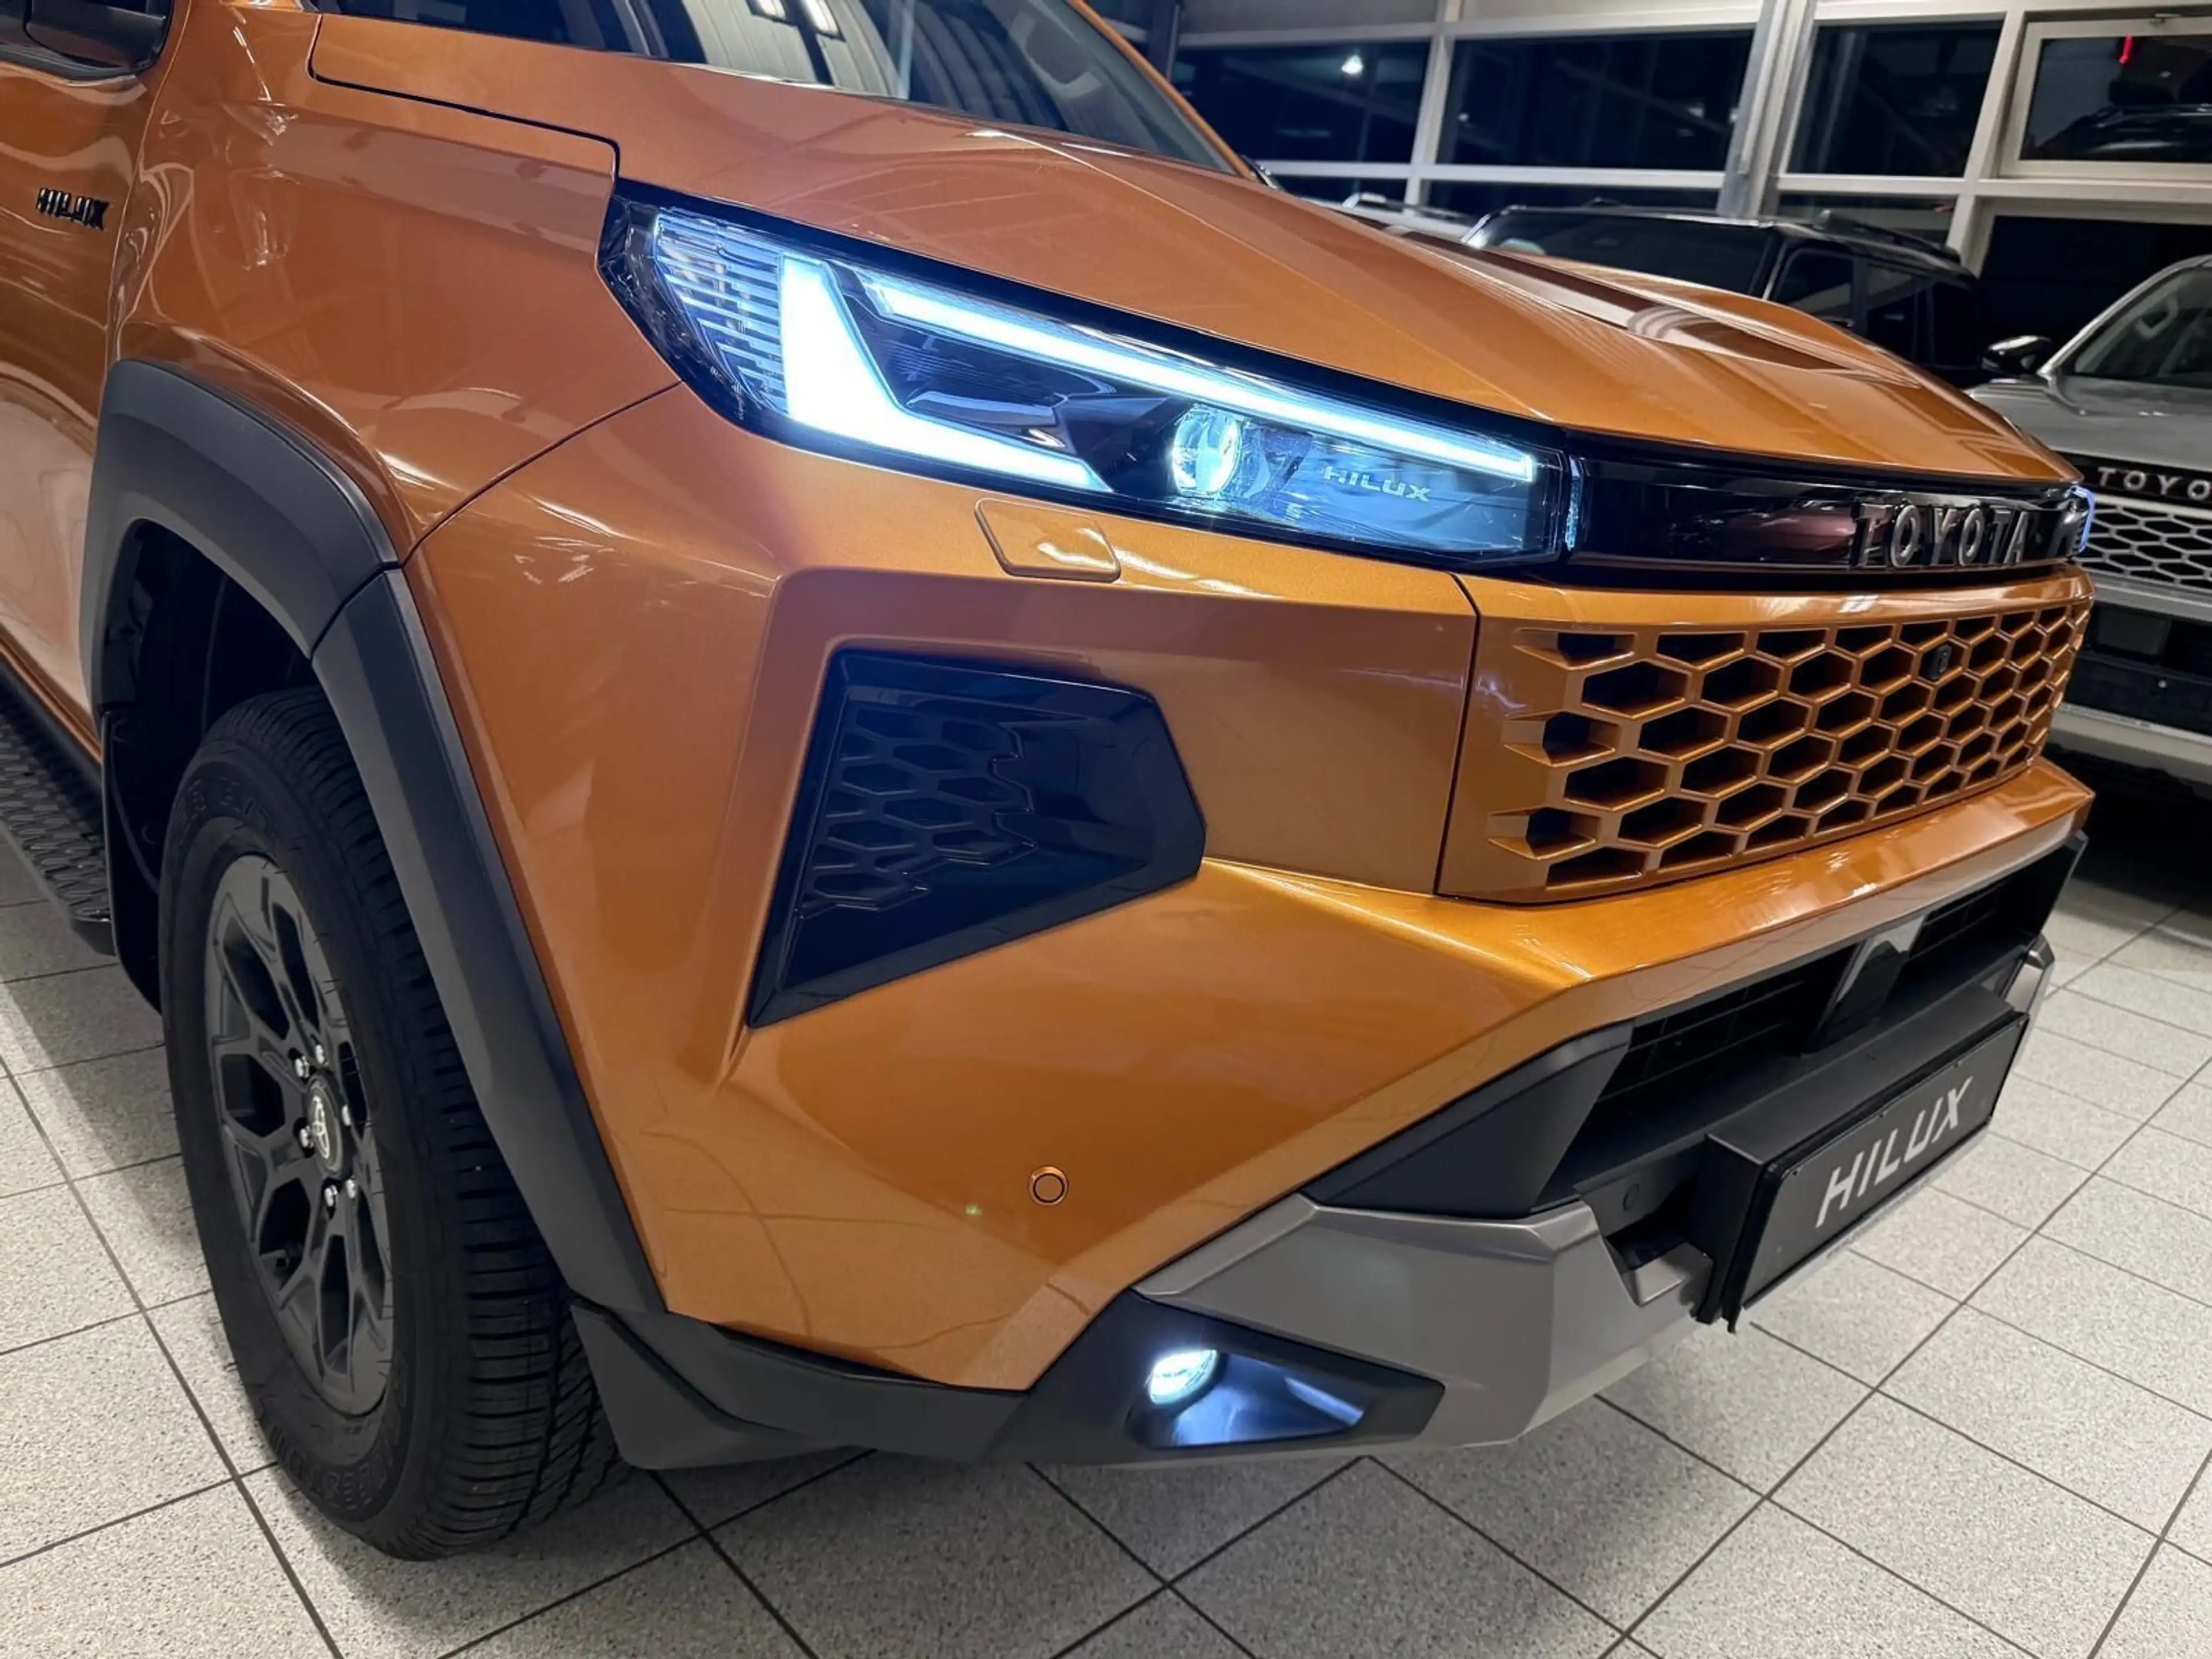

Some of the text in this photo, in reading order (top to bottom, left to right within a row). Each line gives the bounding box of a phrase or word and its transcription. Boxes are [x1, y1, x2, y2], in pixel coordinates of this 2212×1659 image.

[36, 188, 109, 231] HILUX
[1325, 464, 1431, 502] HILUX
[2097, 465, 2212, 501] TOYO
[1854, 501, 2029, 568] TOYOTA
[1815, 1076, 1974, 1228] HILUX
